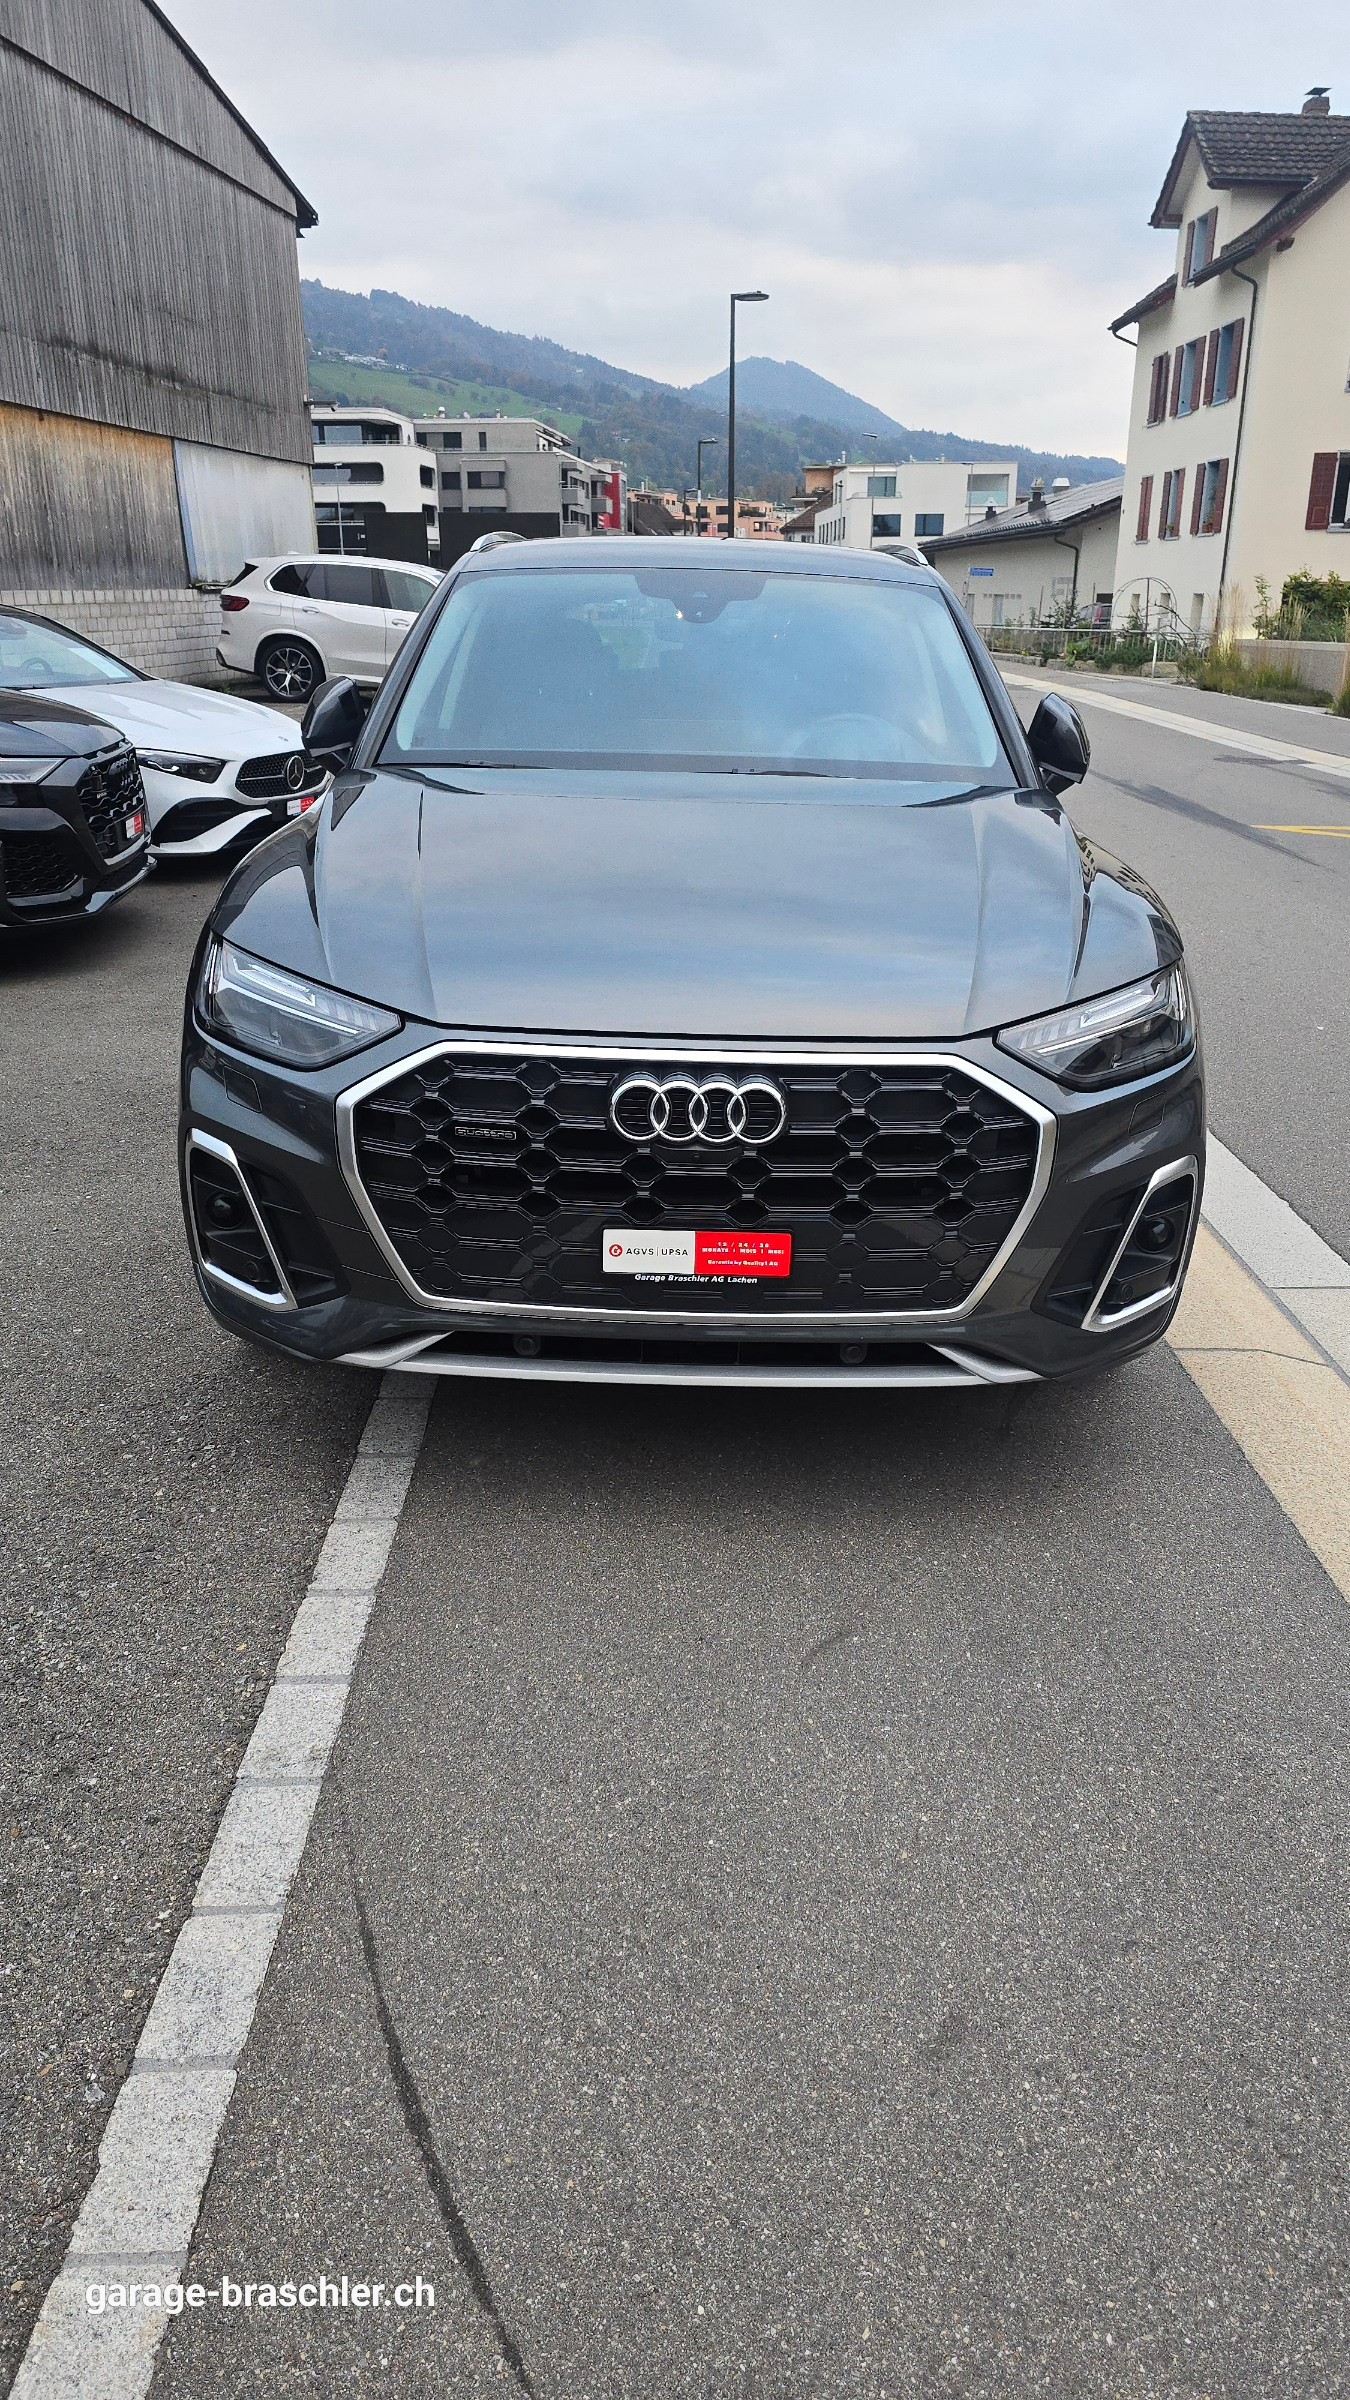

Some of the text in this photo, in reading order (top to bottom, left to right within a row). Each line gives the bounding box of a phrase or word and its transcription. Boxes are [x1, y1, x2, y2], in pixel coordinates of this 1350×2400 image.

[625, 1247, 689, 1256] AGVS UPSA
[634, 1273, 758, 1284] Garage Braschler AG Lachen
